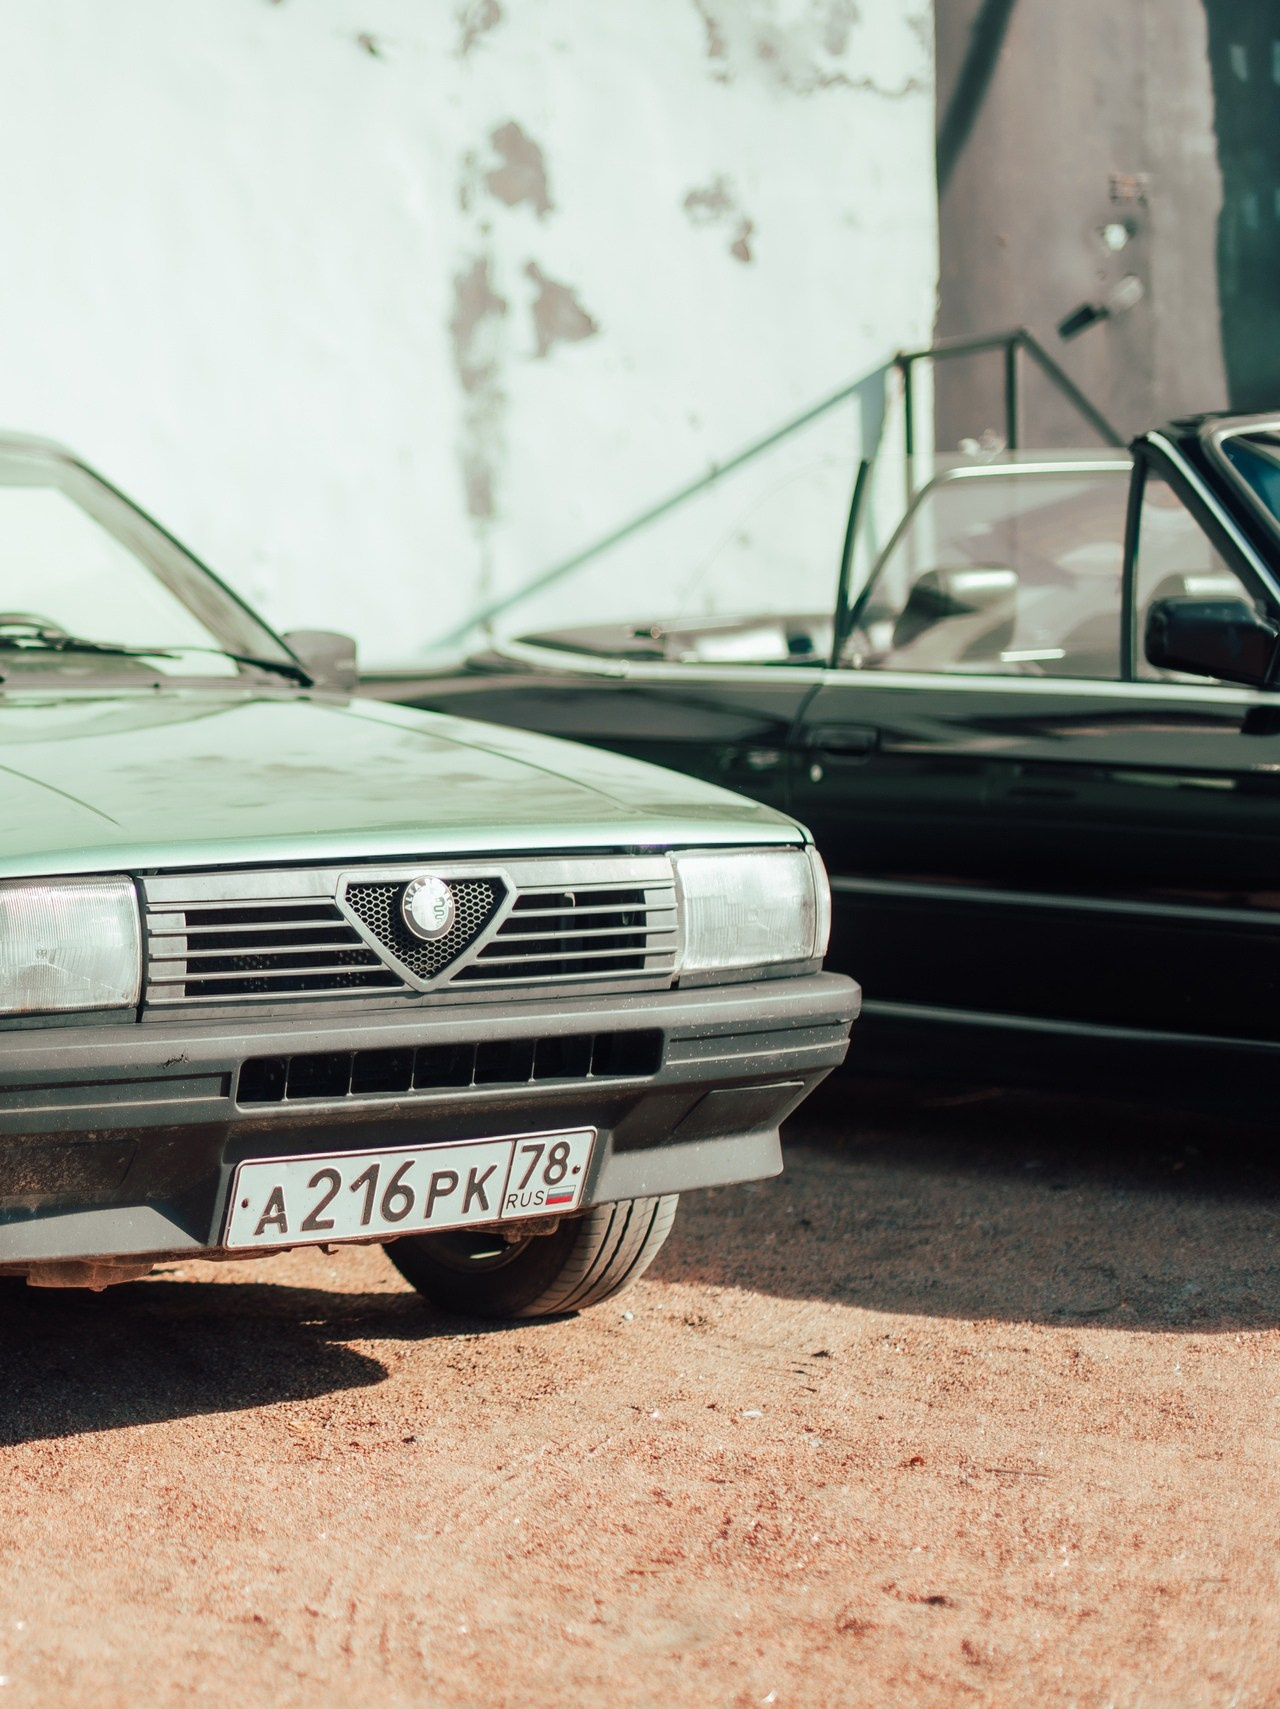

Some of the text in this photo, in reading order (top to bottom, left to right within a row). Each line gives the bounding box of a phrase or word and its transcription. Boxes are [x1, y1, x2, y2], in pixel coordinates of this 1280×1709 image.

[404, 882, 421, 911] ALFA
[519, 1141, 572, 1191] 78
[505, 1190, 545, 1210] RUS
